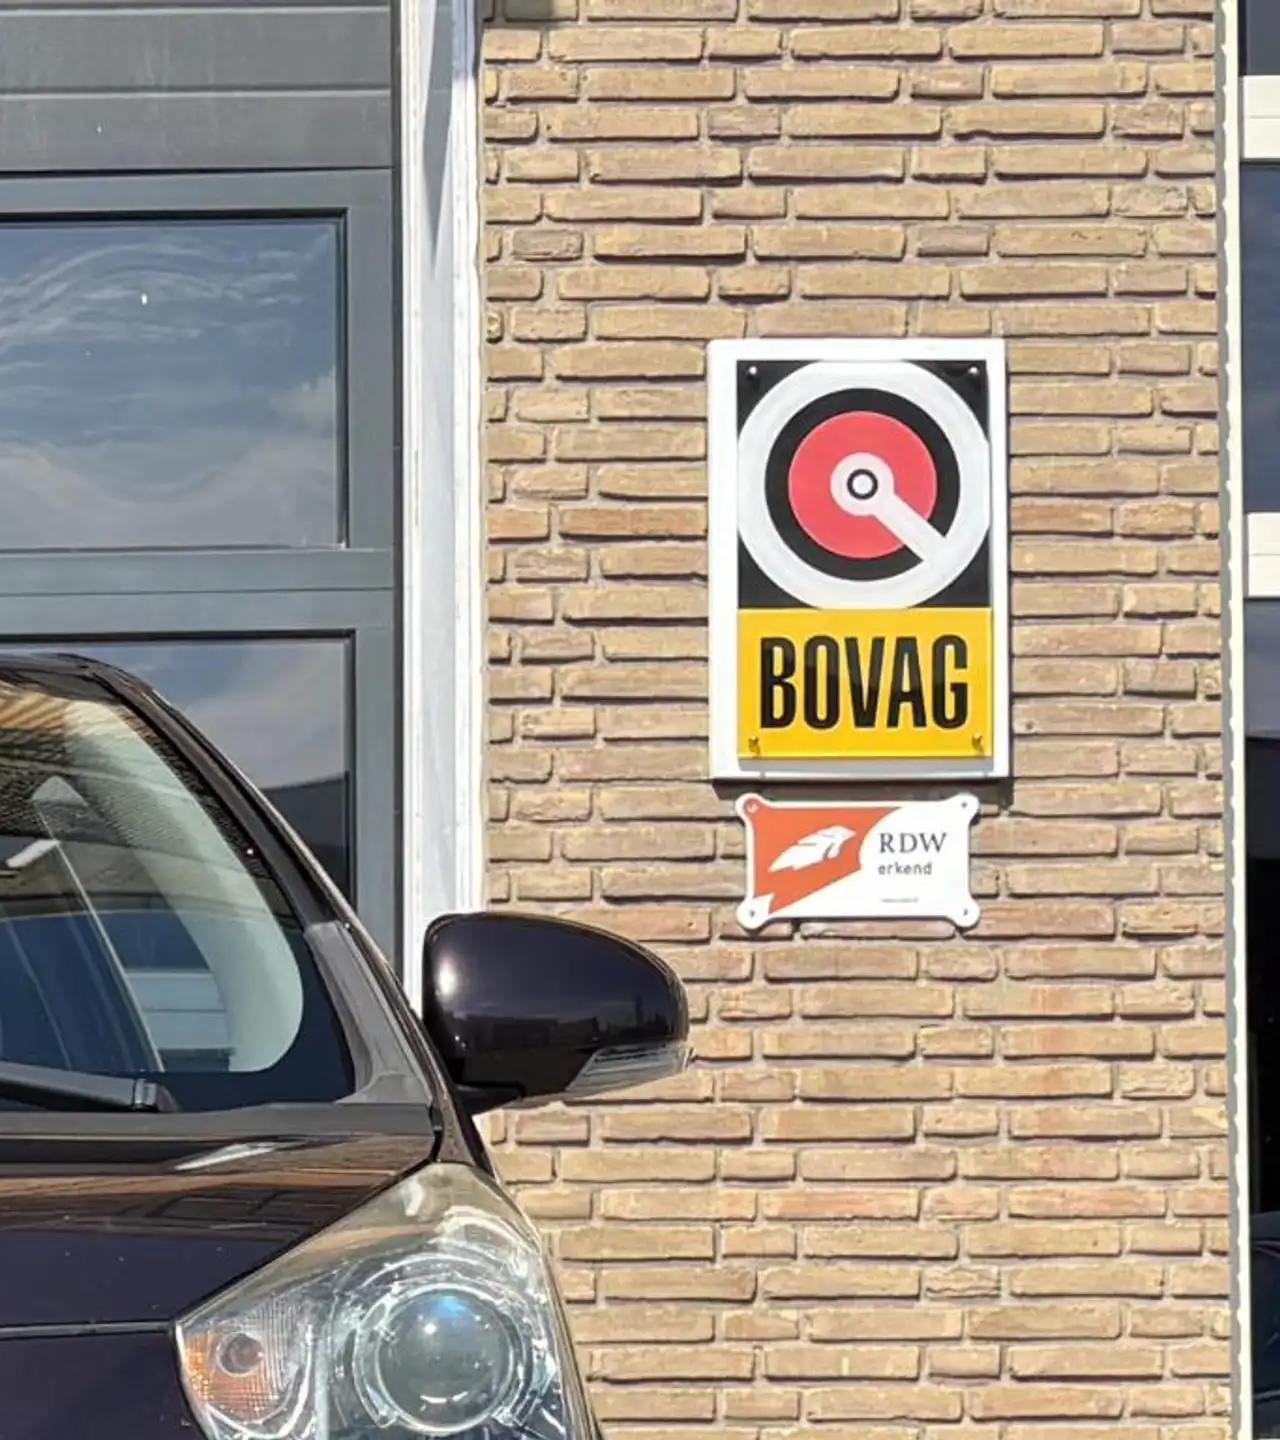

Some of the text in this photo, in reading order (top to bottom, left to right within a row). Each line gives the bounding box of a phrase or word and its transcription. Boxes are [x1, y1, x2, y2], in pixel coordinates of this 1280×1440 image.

[759, 634, 969, 730] BOVAG
[879, 832, 948, 854] RDW
[877, 861, 933, 876] erkend
